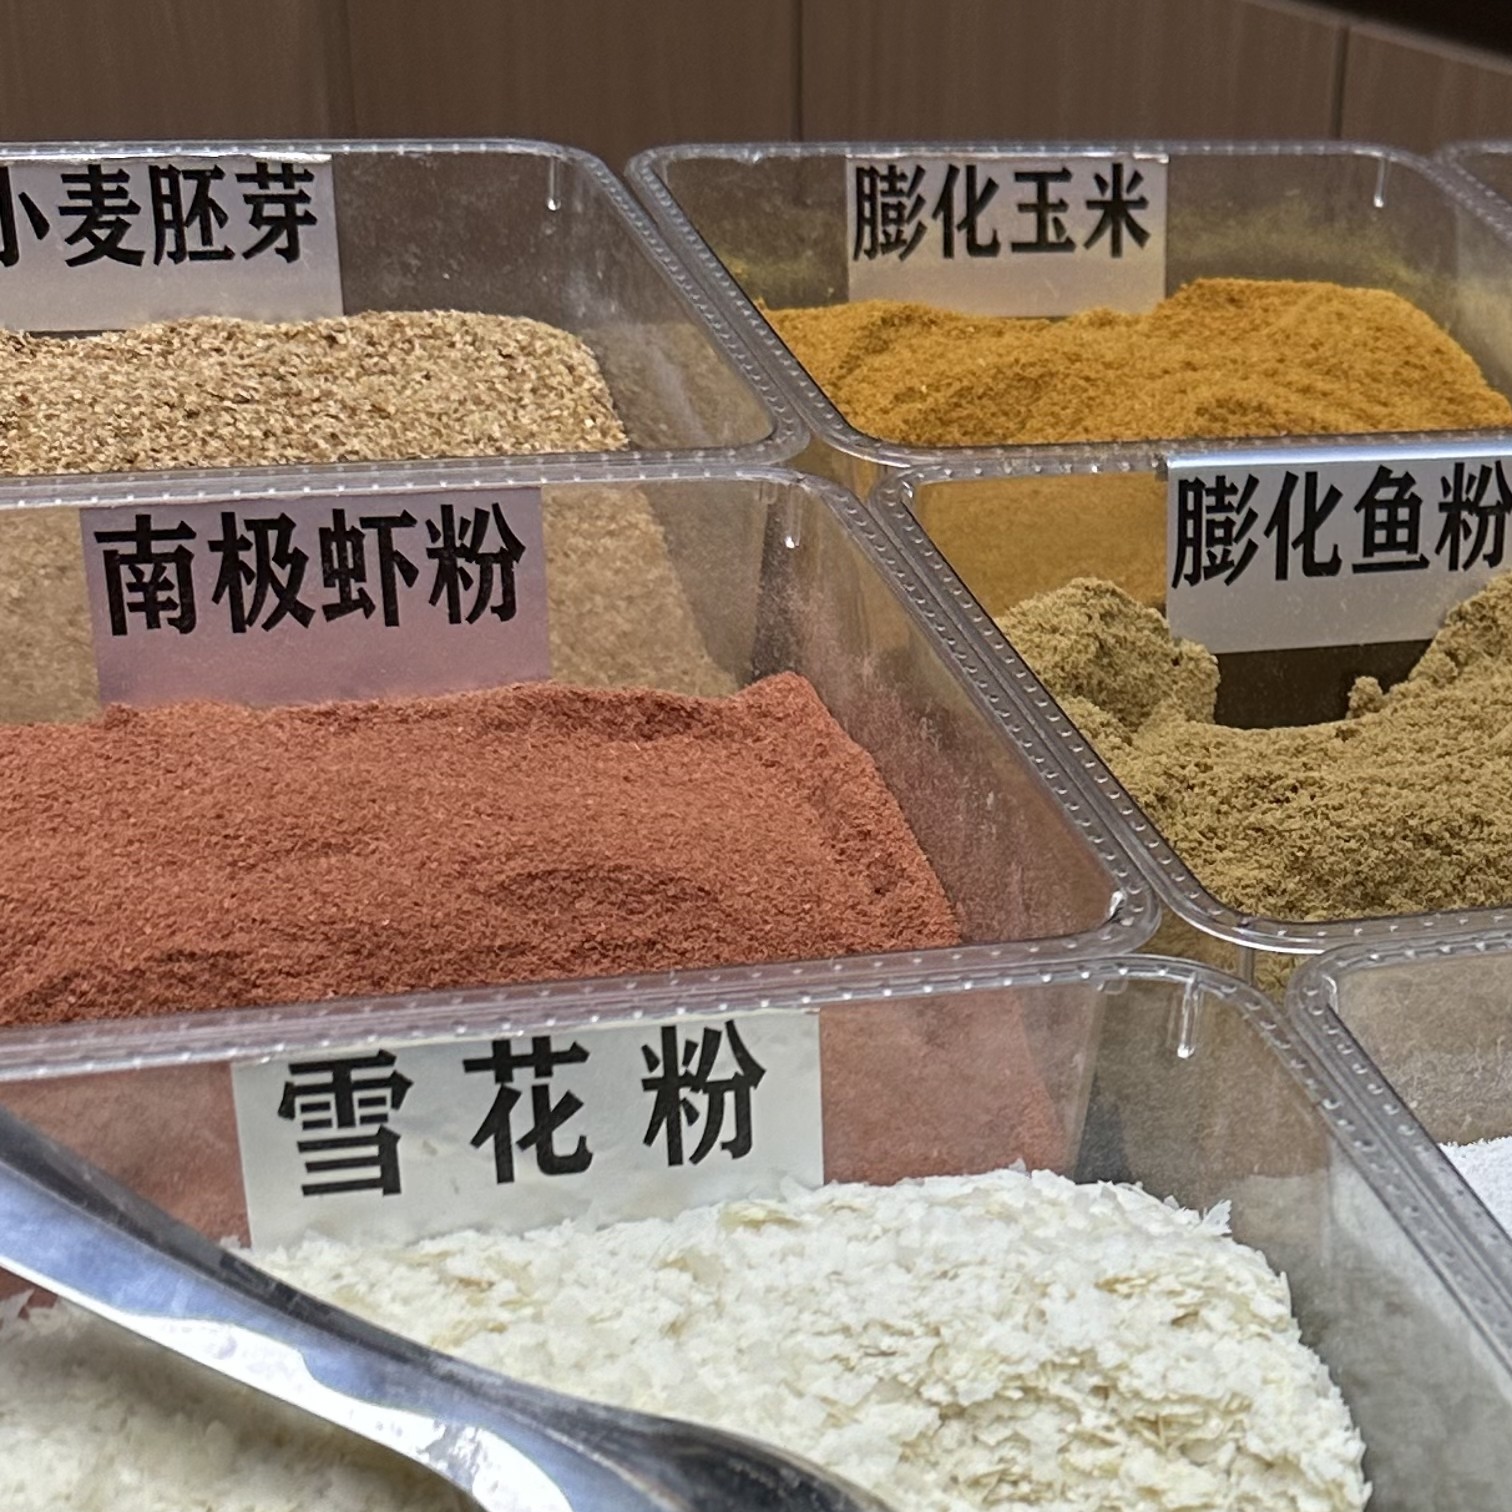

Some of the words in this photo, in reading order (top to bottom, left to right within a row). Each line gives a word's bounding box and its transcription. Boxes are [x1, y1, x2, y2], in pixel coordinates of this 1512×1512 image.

[852, 162, 1152, 263] 膨化玉米
[94, 502, 526, 636] 南极虾粉
[276, 1018, 767, 1198] 雪花粉
